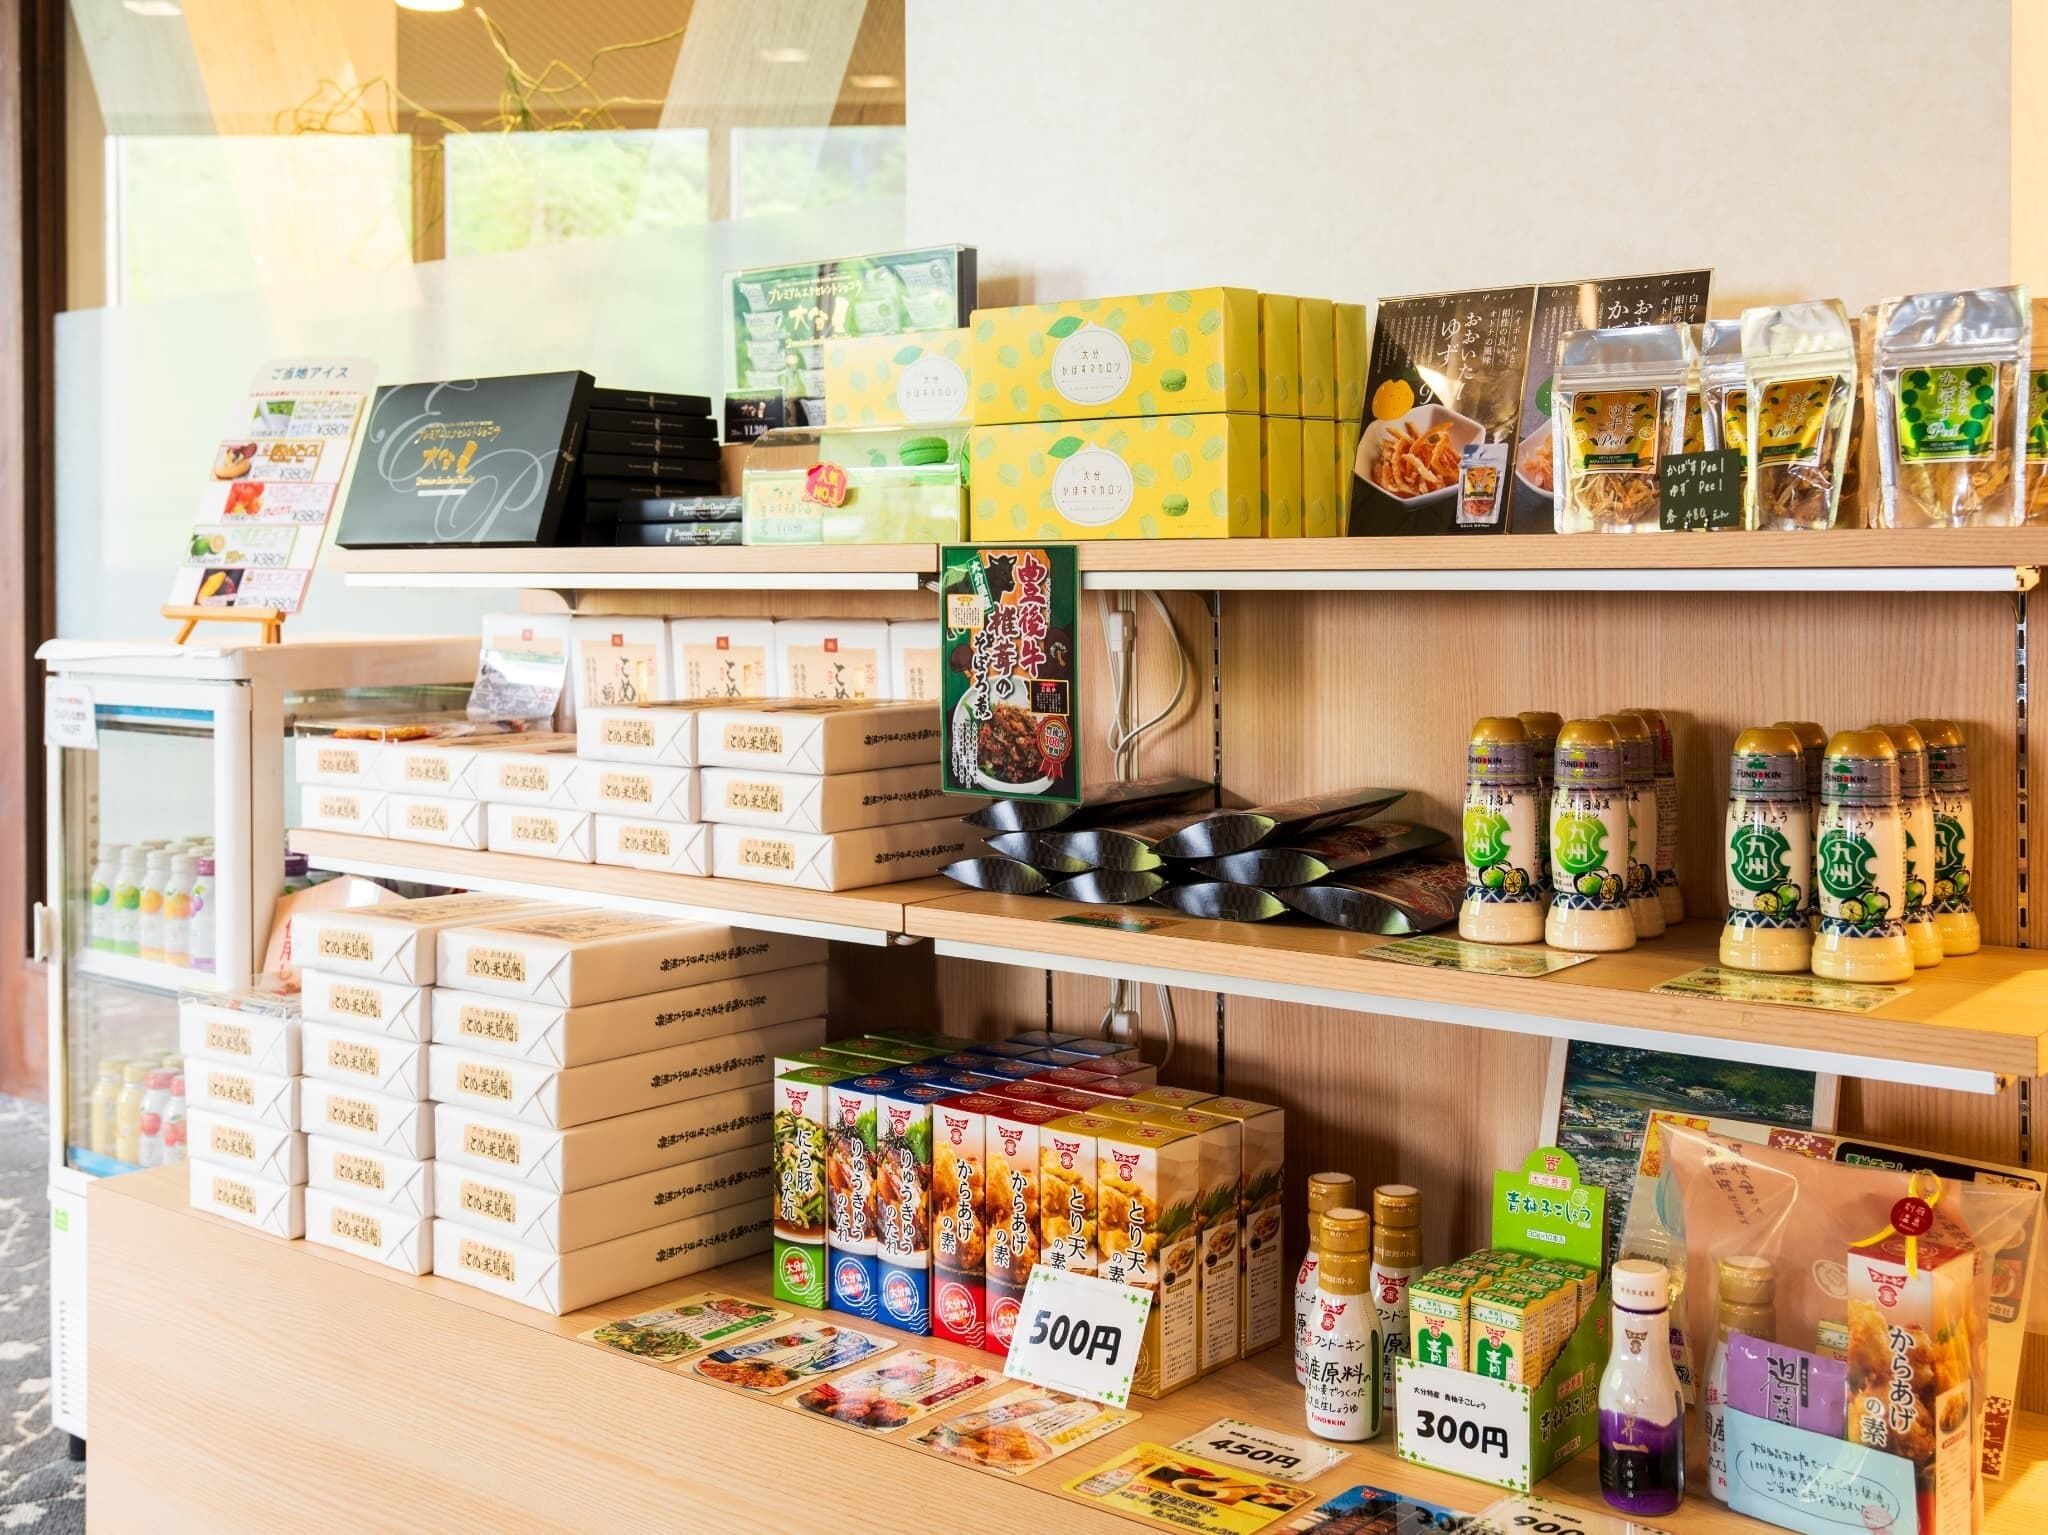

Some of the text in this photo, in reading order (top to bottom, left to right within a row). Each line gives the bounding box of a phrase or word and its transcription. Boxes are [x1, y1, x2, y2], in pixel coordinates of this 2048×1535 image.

[1082, 350, 1100, 360] 大分
[1437, 318, 1461, 368] ゆず
[272, 367, 349, 381] ご当地アイス
[1062, 362, 1121, 377] かぼすマカロン
[1083, 471, 1101, 482] 大分
[1667, 457, 1725, 478] かぼす Peel
[1063, 483, 1123, 498] かぼすマカロン
[1669, 479, 1723, 497] ゆず Peel
[1017, 552, 1048, 678] 豊後牛
[1471, 820, 1491, 859] 九州
[1567, 825, 1588, 864] 九州
[1745, 838, 1769, 878] 九州
[1830, 842, 1853, 885] 九州
[795, 1129, 813, 1193] にら豚
[781, 1171, 796, 1221] のたれ
[851, 1137, 865, 1243] りゅうきゅう
[957, 1159, 973, 1242] からあげ
[1531, 1174, 1571, 1190] 大分特産
[836, 1193, 850, 1243] のたれ
[900, 1149, 914, 1256] りゅうきゅう
[1011, 1170, 1027, 1256] からあげ
[1506, 1190, 1593, 1223] 青柚子こしょう
[885, 1206, 899, 1256] のたれ
[941, 1217, 956, 1254] の素
[1067, 1188, 1087, 1261] とり天
[1127, 1199, 1147, 1275] とり天
[993, 1230, 1010, 1268] の素
[1050, 1238, 1067, 1271] の素
[1108, 1252, 1126, 1285] の素
[1029, 1309, 1123, 1367] 500円
[1314, 1336, 1366, 1352] フンドーキン
[1413, 1386, 1487, 1410] 大分特産 青柚子こしょう
[1890, 1327, 1917, 1434] からあげ
[1416, 1409, 1509, 1459] 300円
[1861, 1396, 1888, 1448] の素
[1208, 1439, 1303, 1469] 450円
